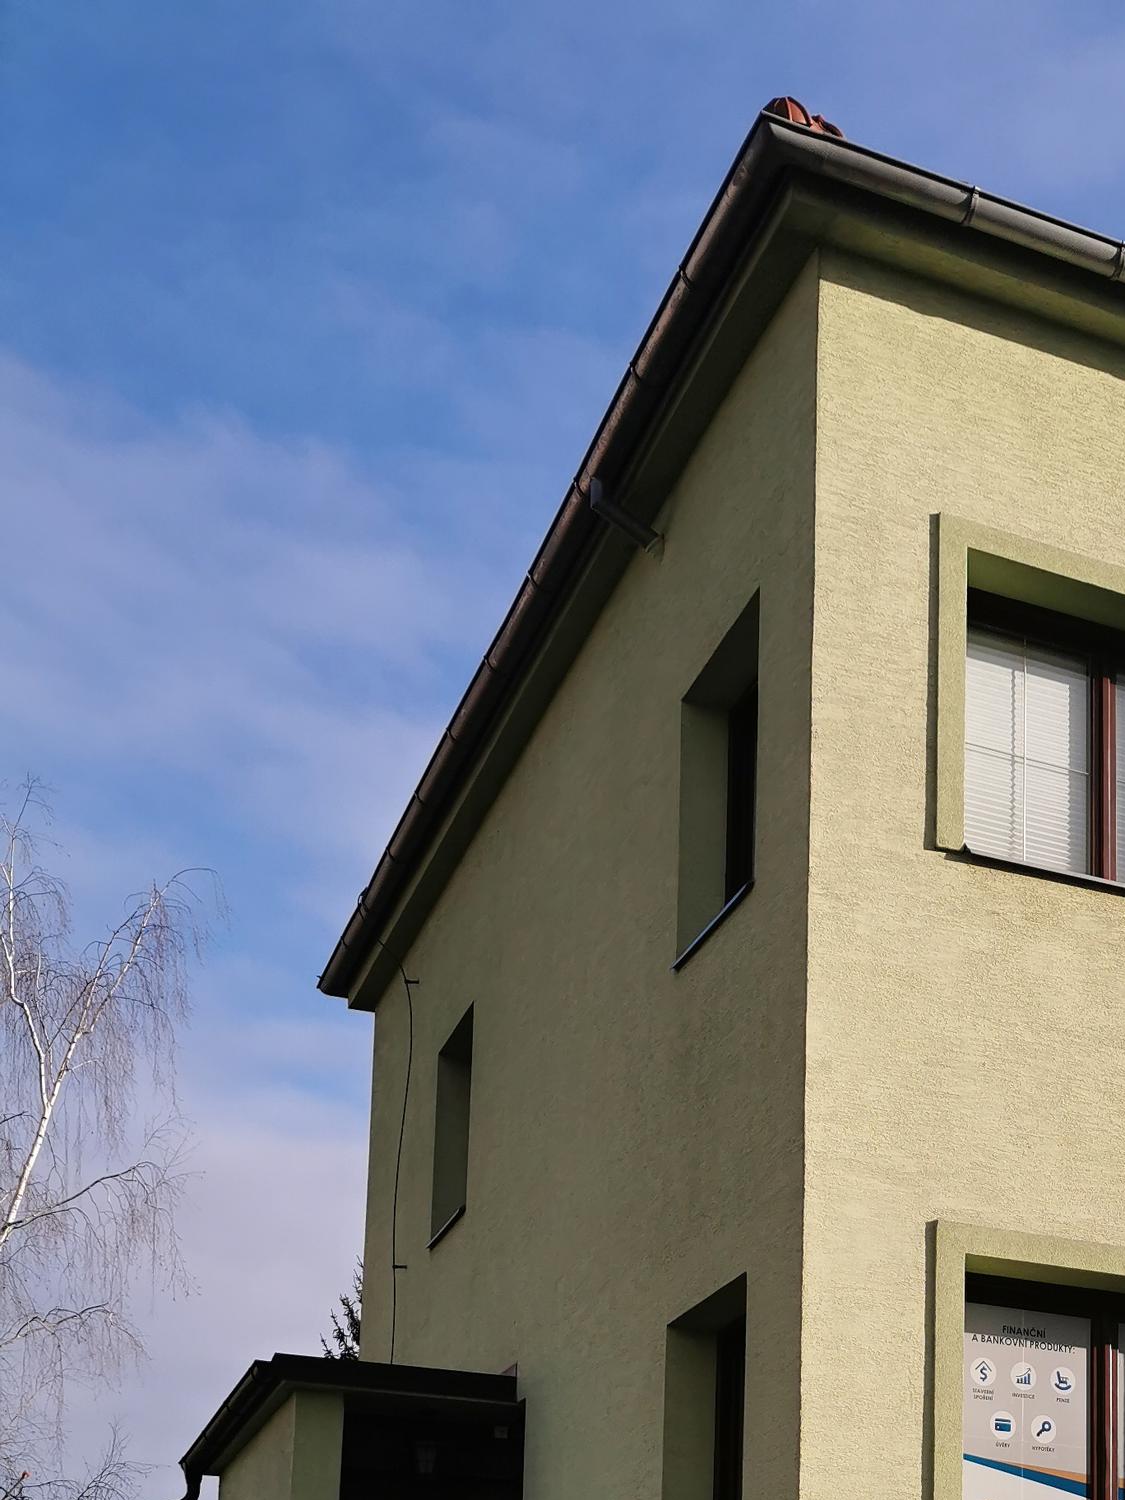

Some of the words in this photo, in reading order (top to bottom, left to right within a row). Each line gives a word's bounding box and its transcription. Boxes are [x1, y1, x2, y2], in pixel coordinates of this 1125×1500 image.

[1002, 1325, 1046, 1338] FINANČNÍ
[971, 1333, 979, 1342] A
[981, 1334, 1028, 1348] BANKOVNÍ
[1030, 1340, 1076, 1354] PRODUKTY:
